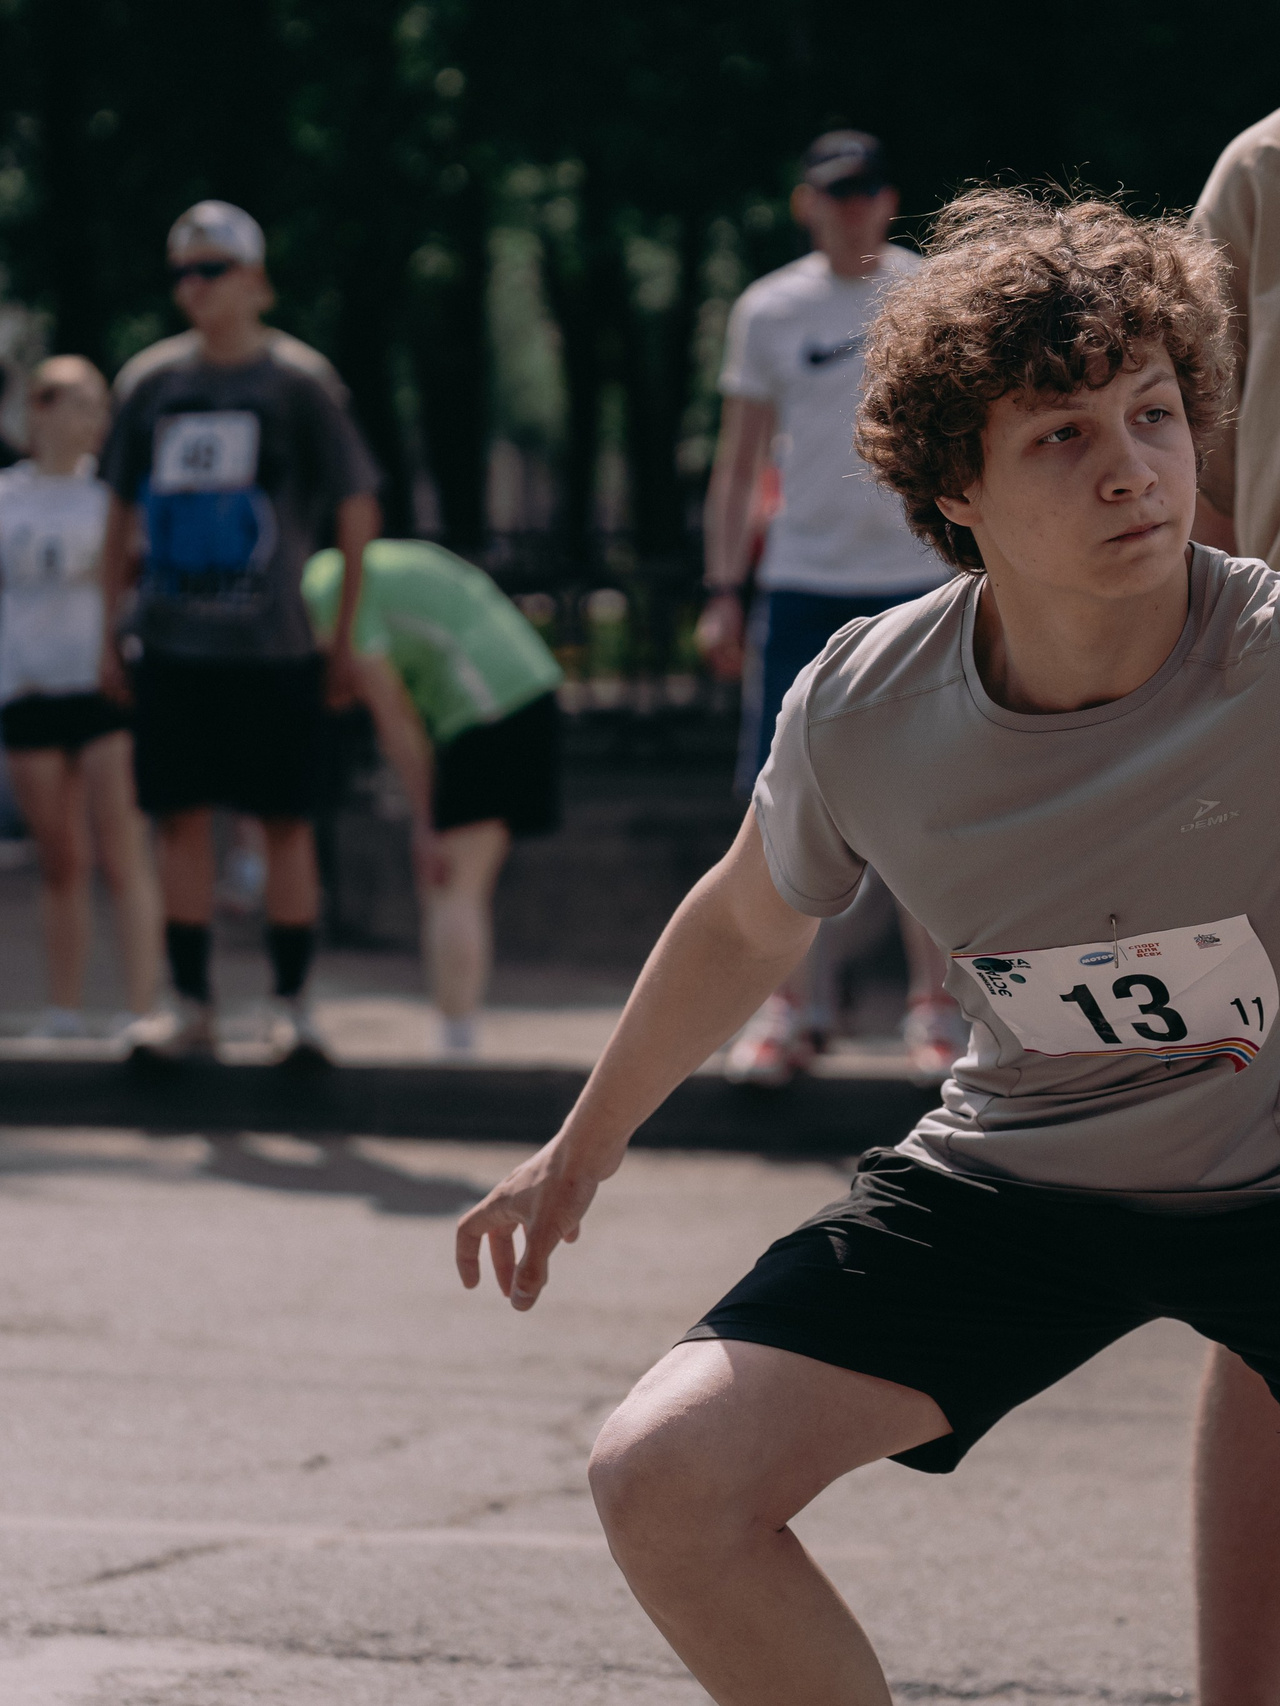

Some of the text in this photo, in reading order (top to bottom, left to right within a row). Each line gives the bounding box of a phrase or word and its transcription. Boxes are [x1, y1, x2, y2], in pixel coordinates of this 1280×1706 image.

[1181, 811, 1239, 833] DEMIX
[1059, 973, 1188, 1044] 13
[1230, 996, 1264, 1032] 11
